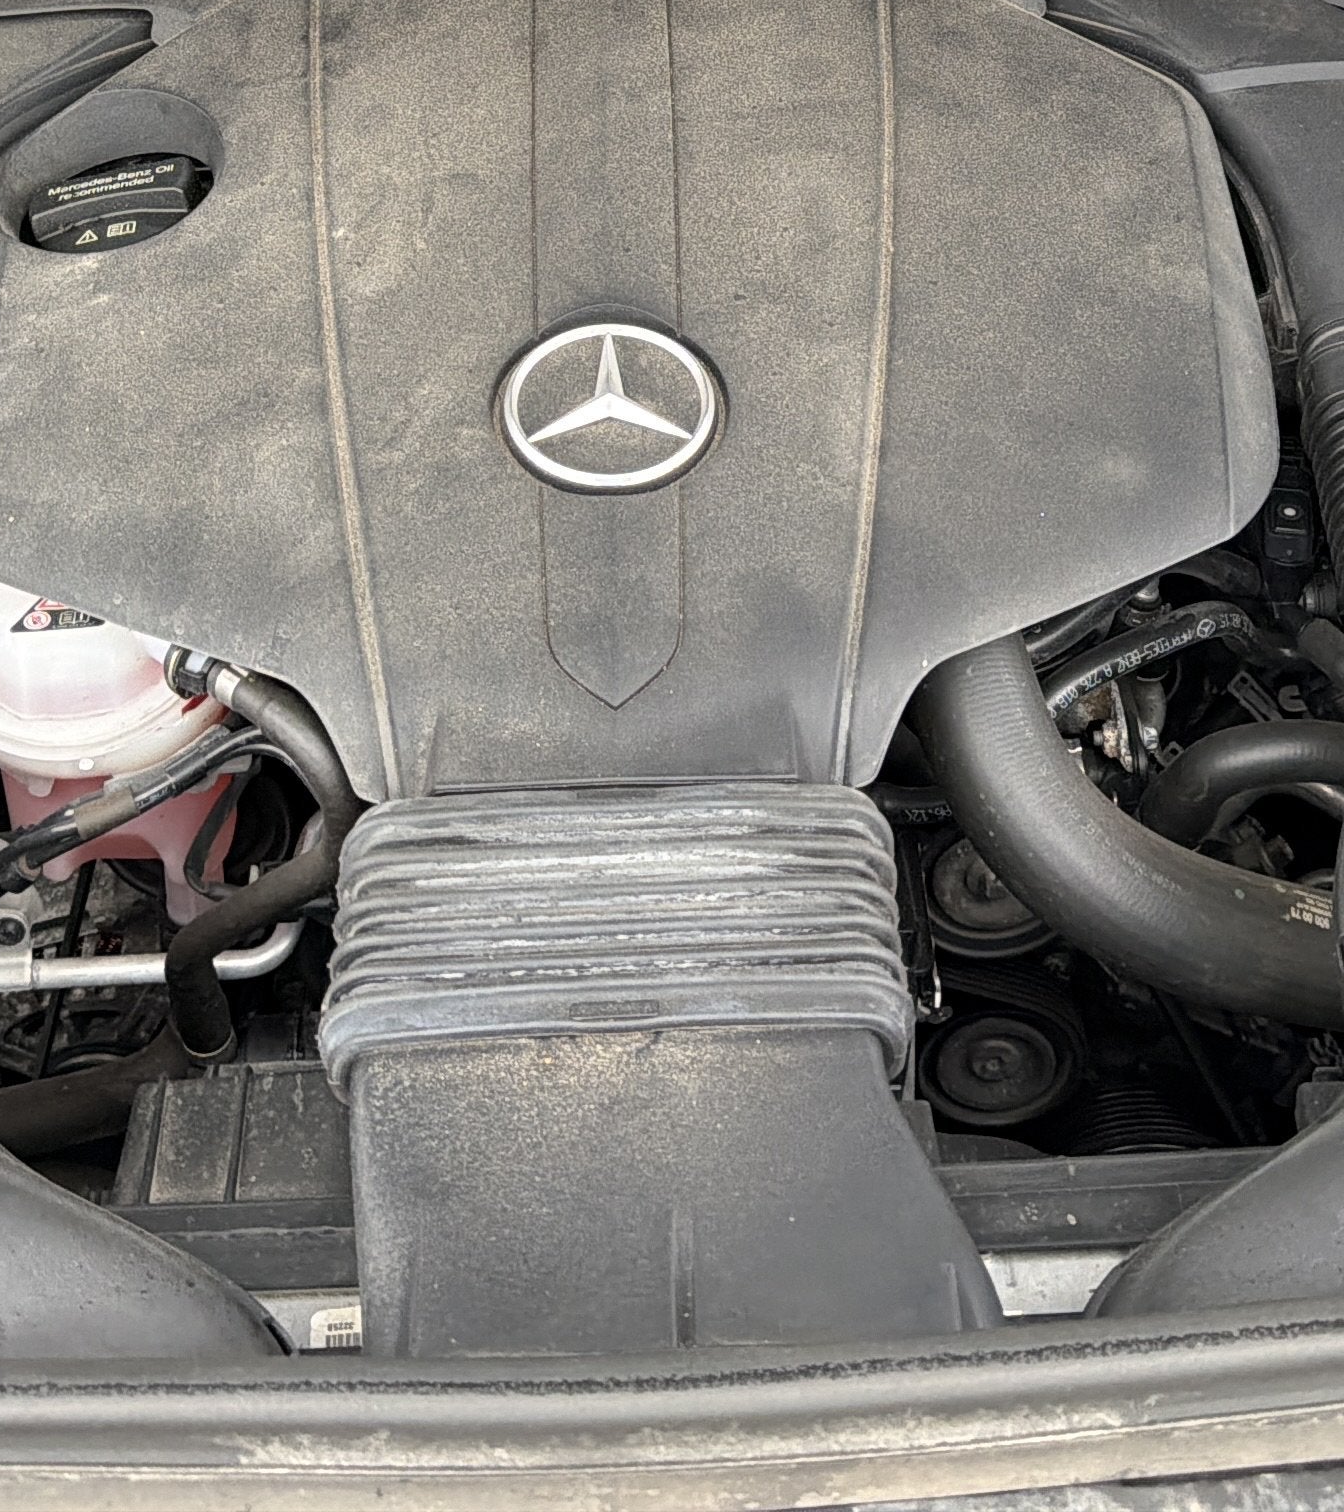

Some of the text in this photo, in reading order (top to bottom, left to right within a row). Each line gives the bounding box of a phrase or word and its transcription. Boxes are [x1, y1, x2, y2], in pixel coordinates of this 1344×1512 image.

[48, 164, 174, 197] Mercedes-Benz Oil
[58, 176, 154, 201] recommended
